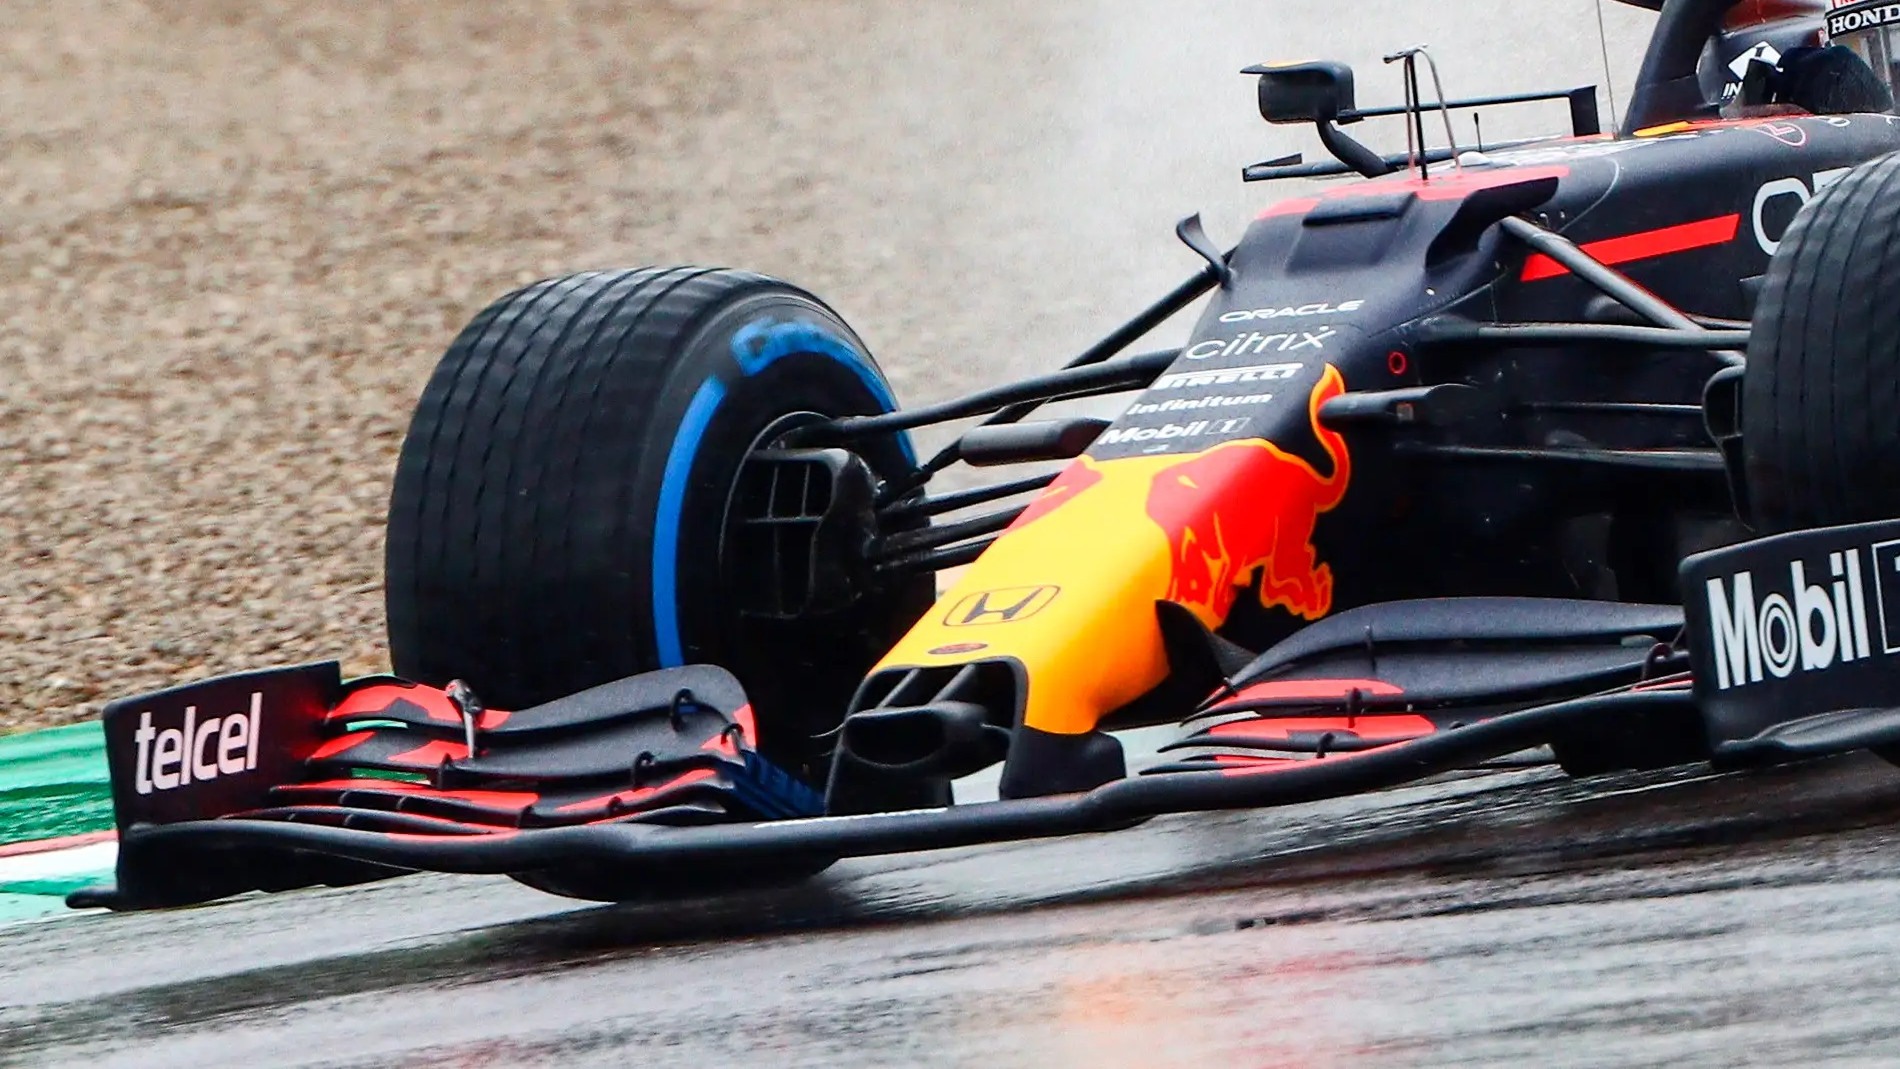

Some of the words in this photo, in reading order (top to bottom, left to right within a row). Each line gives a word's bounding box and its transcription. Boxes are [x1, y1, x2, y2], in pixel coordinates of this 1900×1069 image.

[1219, 300, 1365, 322] ORACLE
[1150, 362, 1304, 391] PIRELLI
[1127, 394, 1273, 415] infinitum
[1098, 420, 1209, 445] Mobil
[1706, 548, 1871, 689] Mobil
[135, 692, 263, 794] telcel
